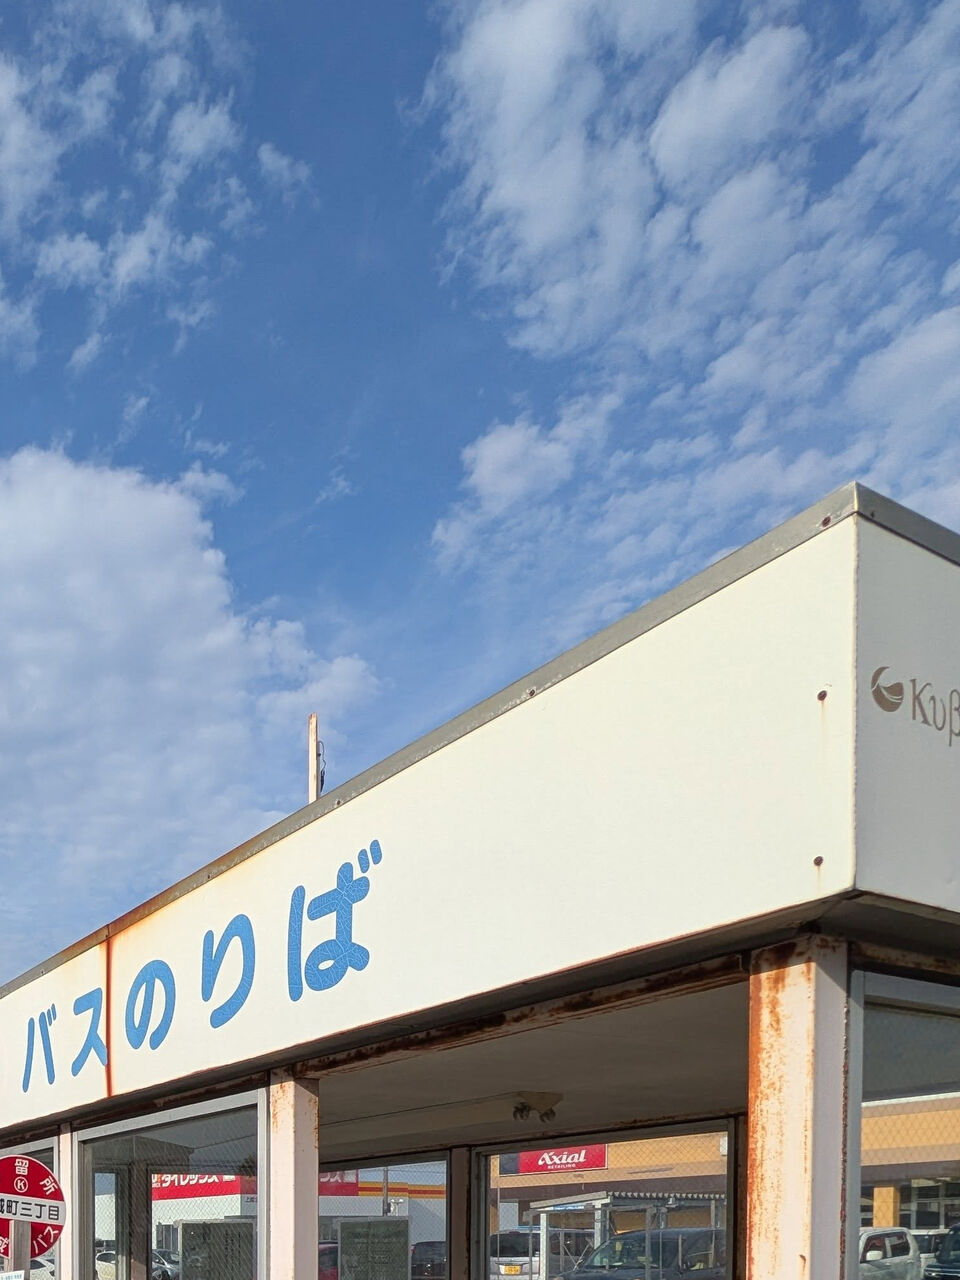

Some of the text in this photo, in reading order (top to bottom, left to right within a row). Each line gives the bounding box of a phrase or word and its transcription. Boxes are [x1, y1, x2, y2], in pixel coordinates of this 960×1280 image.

[22, 839, 383, 1093] バスのりば
[538, 1149, 587, 1166] Axial
[32, 1226, 59, 1255] バス
